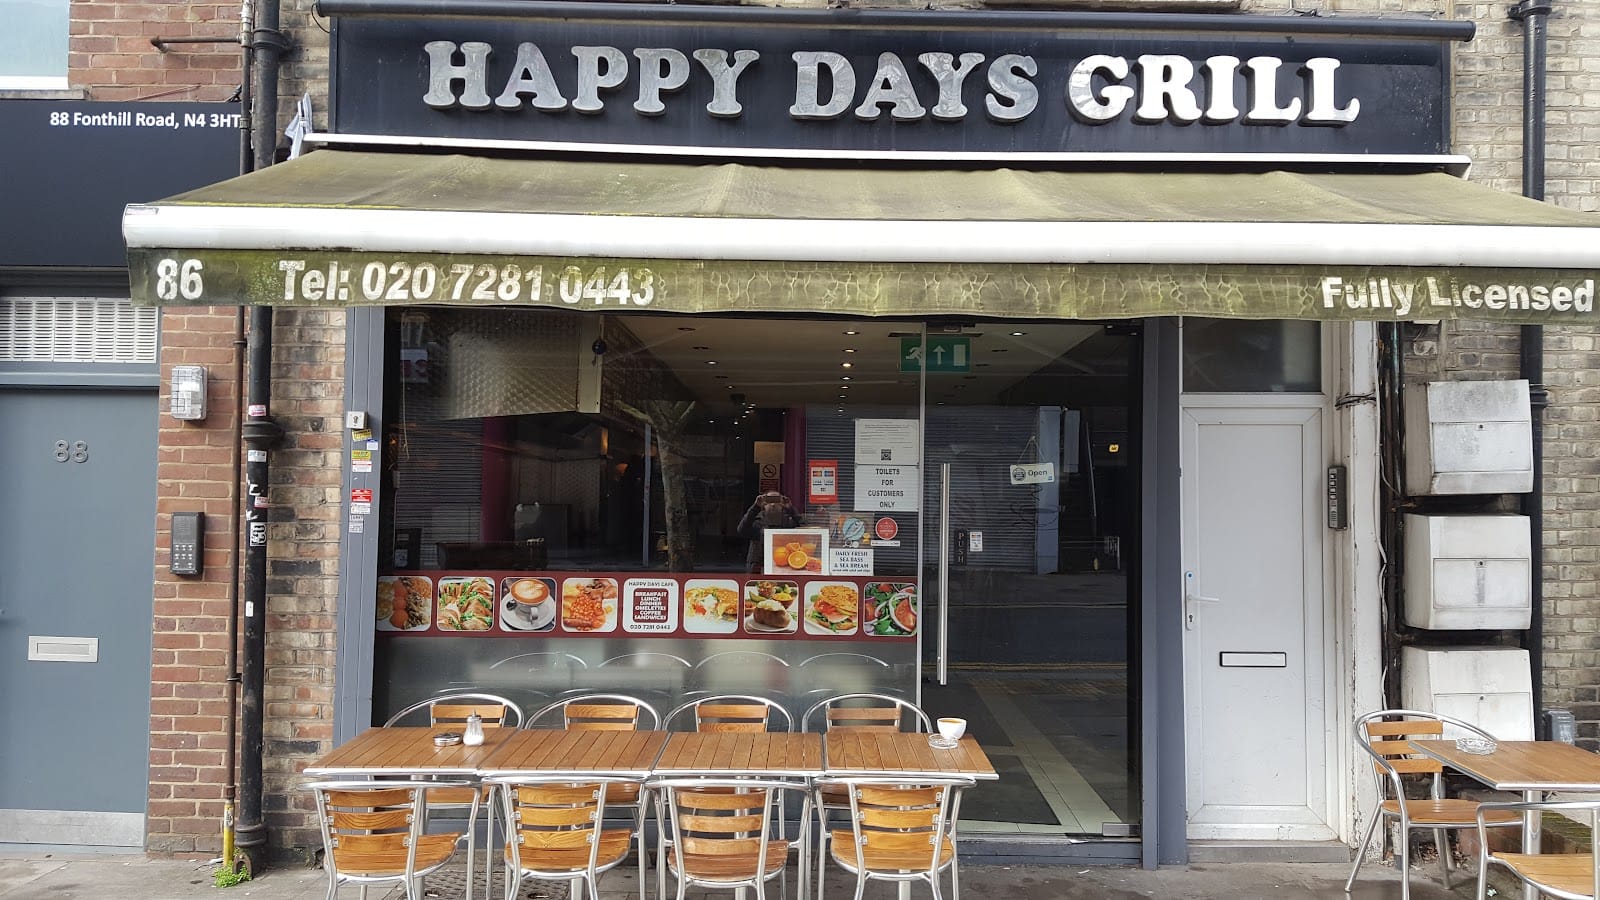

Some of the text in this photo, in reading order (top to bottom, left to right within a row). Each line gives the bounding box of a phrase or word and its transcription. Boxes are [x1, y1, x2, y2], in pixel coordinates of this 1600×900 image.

[423, 41, 1361, 126] HAPPY DAYS GRILL
[50, 111, 241, 130] 88 Fonthill Road, N4 3HT
[157, 258, 203, 300] 86
[279, 260, 654, 306] Tel: 020 7281 0443
[1321, 276, 1595, 316] Fully Licensed
[54, 439, 89, 464] 88
[1028, 469, 1048, 477] Open
